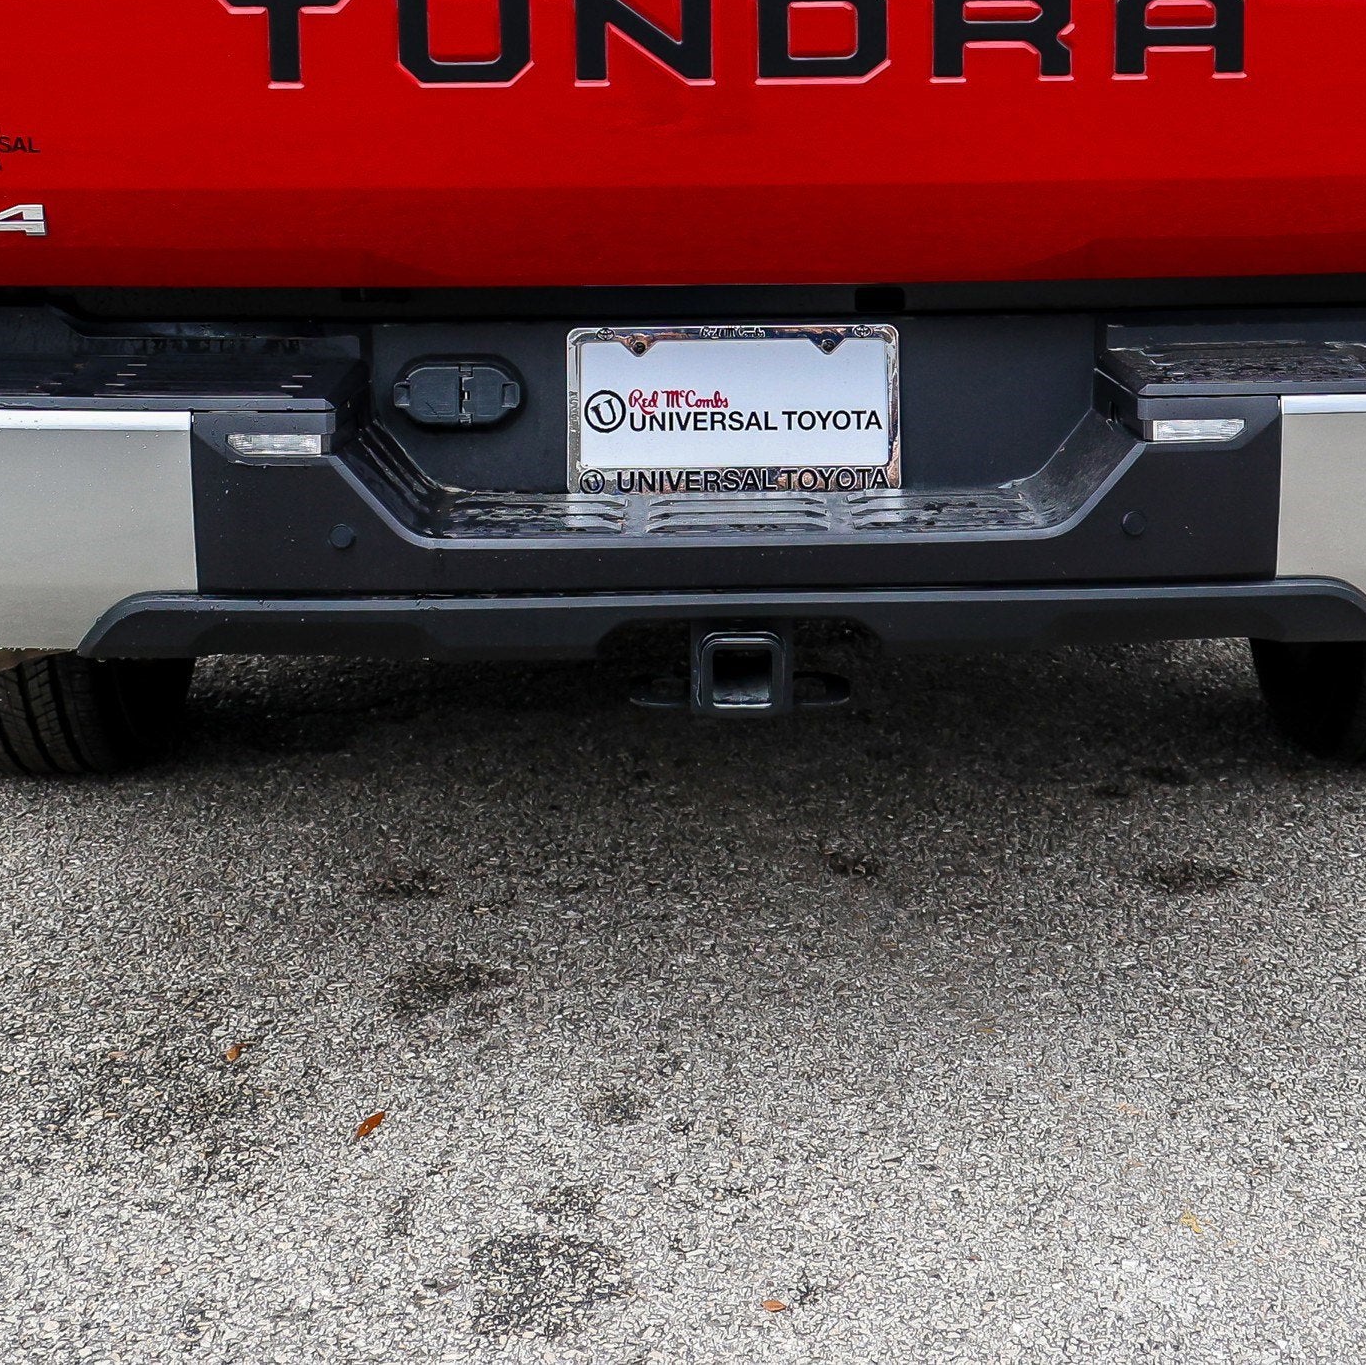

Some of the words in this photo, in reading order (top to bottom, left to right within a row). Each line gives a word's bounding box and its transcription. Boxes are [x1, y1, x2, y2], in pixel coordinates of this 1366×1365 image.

[628, 388, 659, 416] Red
[629, 410, 778, 432] UNIVERSAL
[782, 409, 883, 431] TOYOTA
[616, 467, 778, 493] UNIVERSAL
[780, 466, 891, 492] TOYOTA
